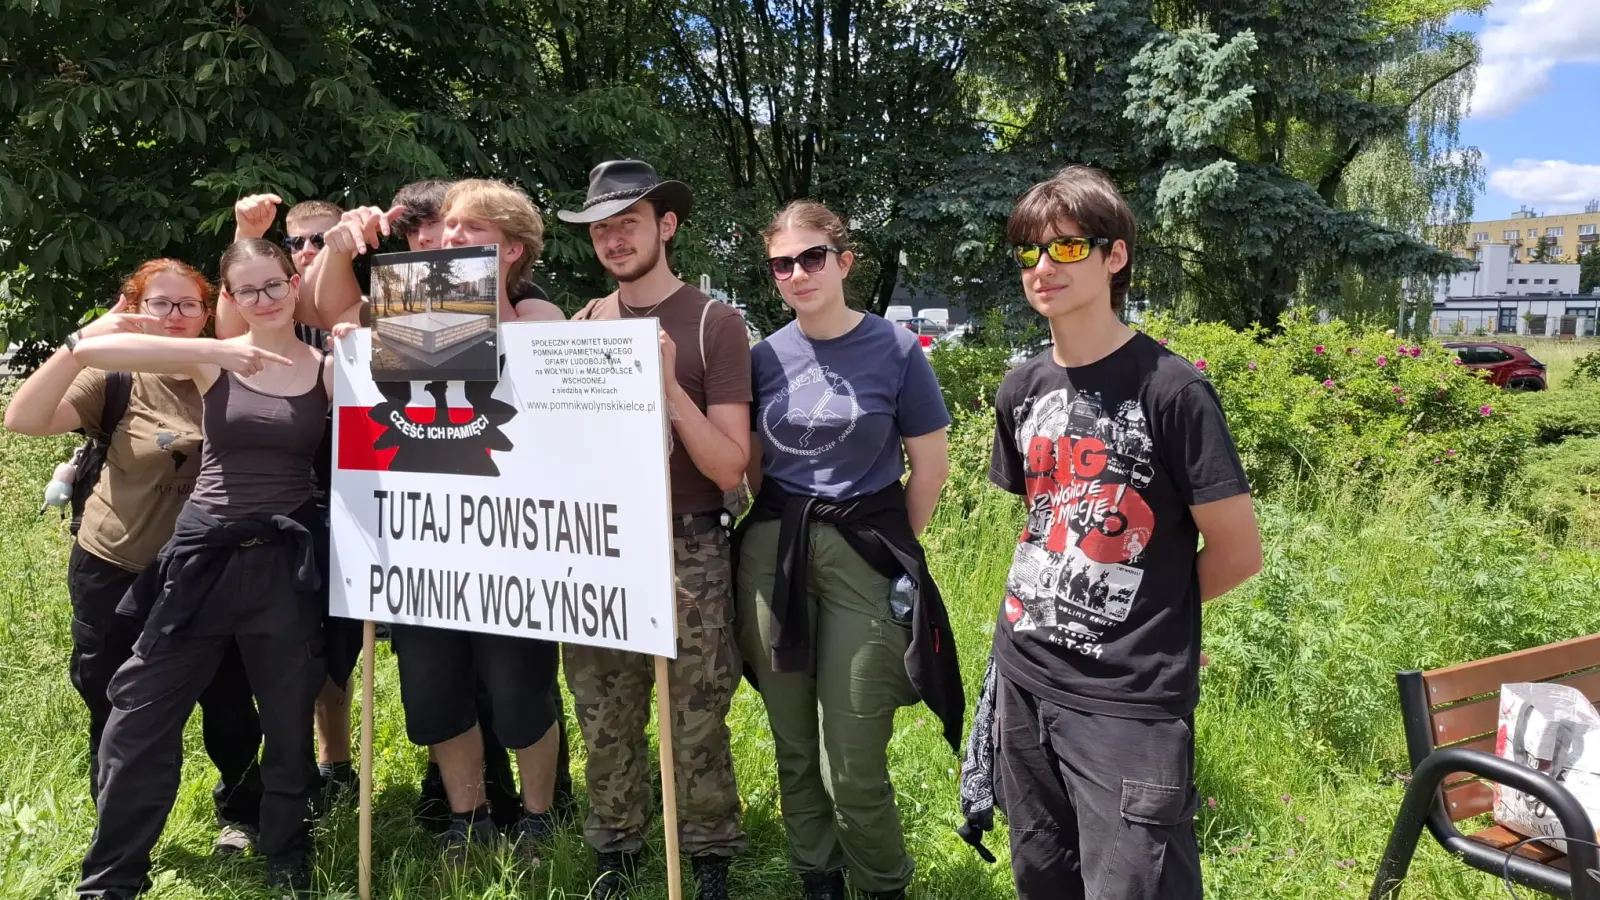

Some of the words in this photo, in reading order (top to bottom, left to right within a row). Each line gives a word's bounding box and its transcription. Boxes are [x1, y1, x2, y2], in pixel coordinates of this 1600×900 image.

[531, 339, 569, 347] SPOŁECZNY
[572, 338, 601, 346] KOMITET
[564, 347, 633, 357] UPAMIĘTNIAJĄCEGO
[545, 358, 568, 366] OFIARY
[570, 357, 621, 365] LUDOBÓJSTWA
[544, 367, 574, 375] WOŁYNIU
[586, 367, 633, 375] MAŁOPOLSCE
[561, 377, 606, 385] WSCHODNIEJ
[557, 387, 583, 395] siedzibą
[526, 400, 656, 413] www.pomnikwolynskikielce.pl
[389, 410, 425, 439] CZEŚĆ
[427, 427, 446, 439] ICH
[447, 414, 490, 440] PAMIĘCI
[1028, 435, 1109, 486] BIG
[373, 489, 451, 544] TUTAJ
[460, 493, 621, 558] POWSTANIE
[369, 563, 471, 622] POMNIK
[478, 566, 628, 641] WOŁYŃSKI
[1065, 638, 1103, 660] T-54
